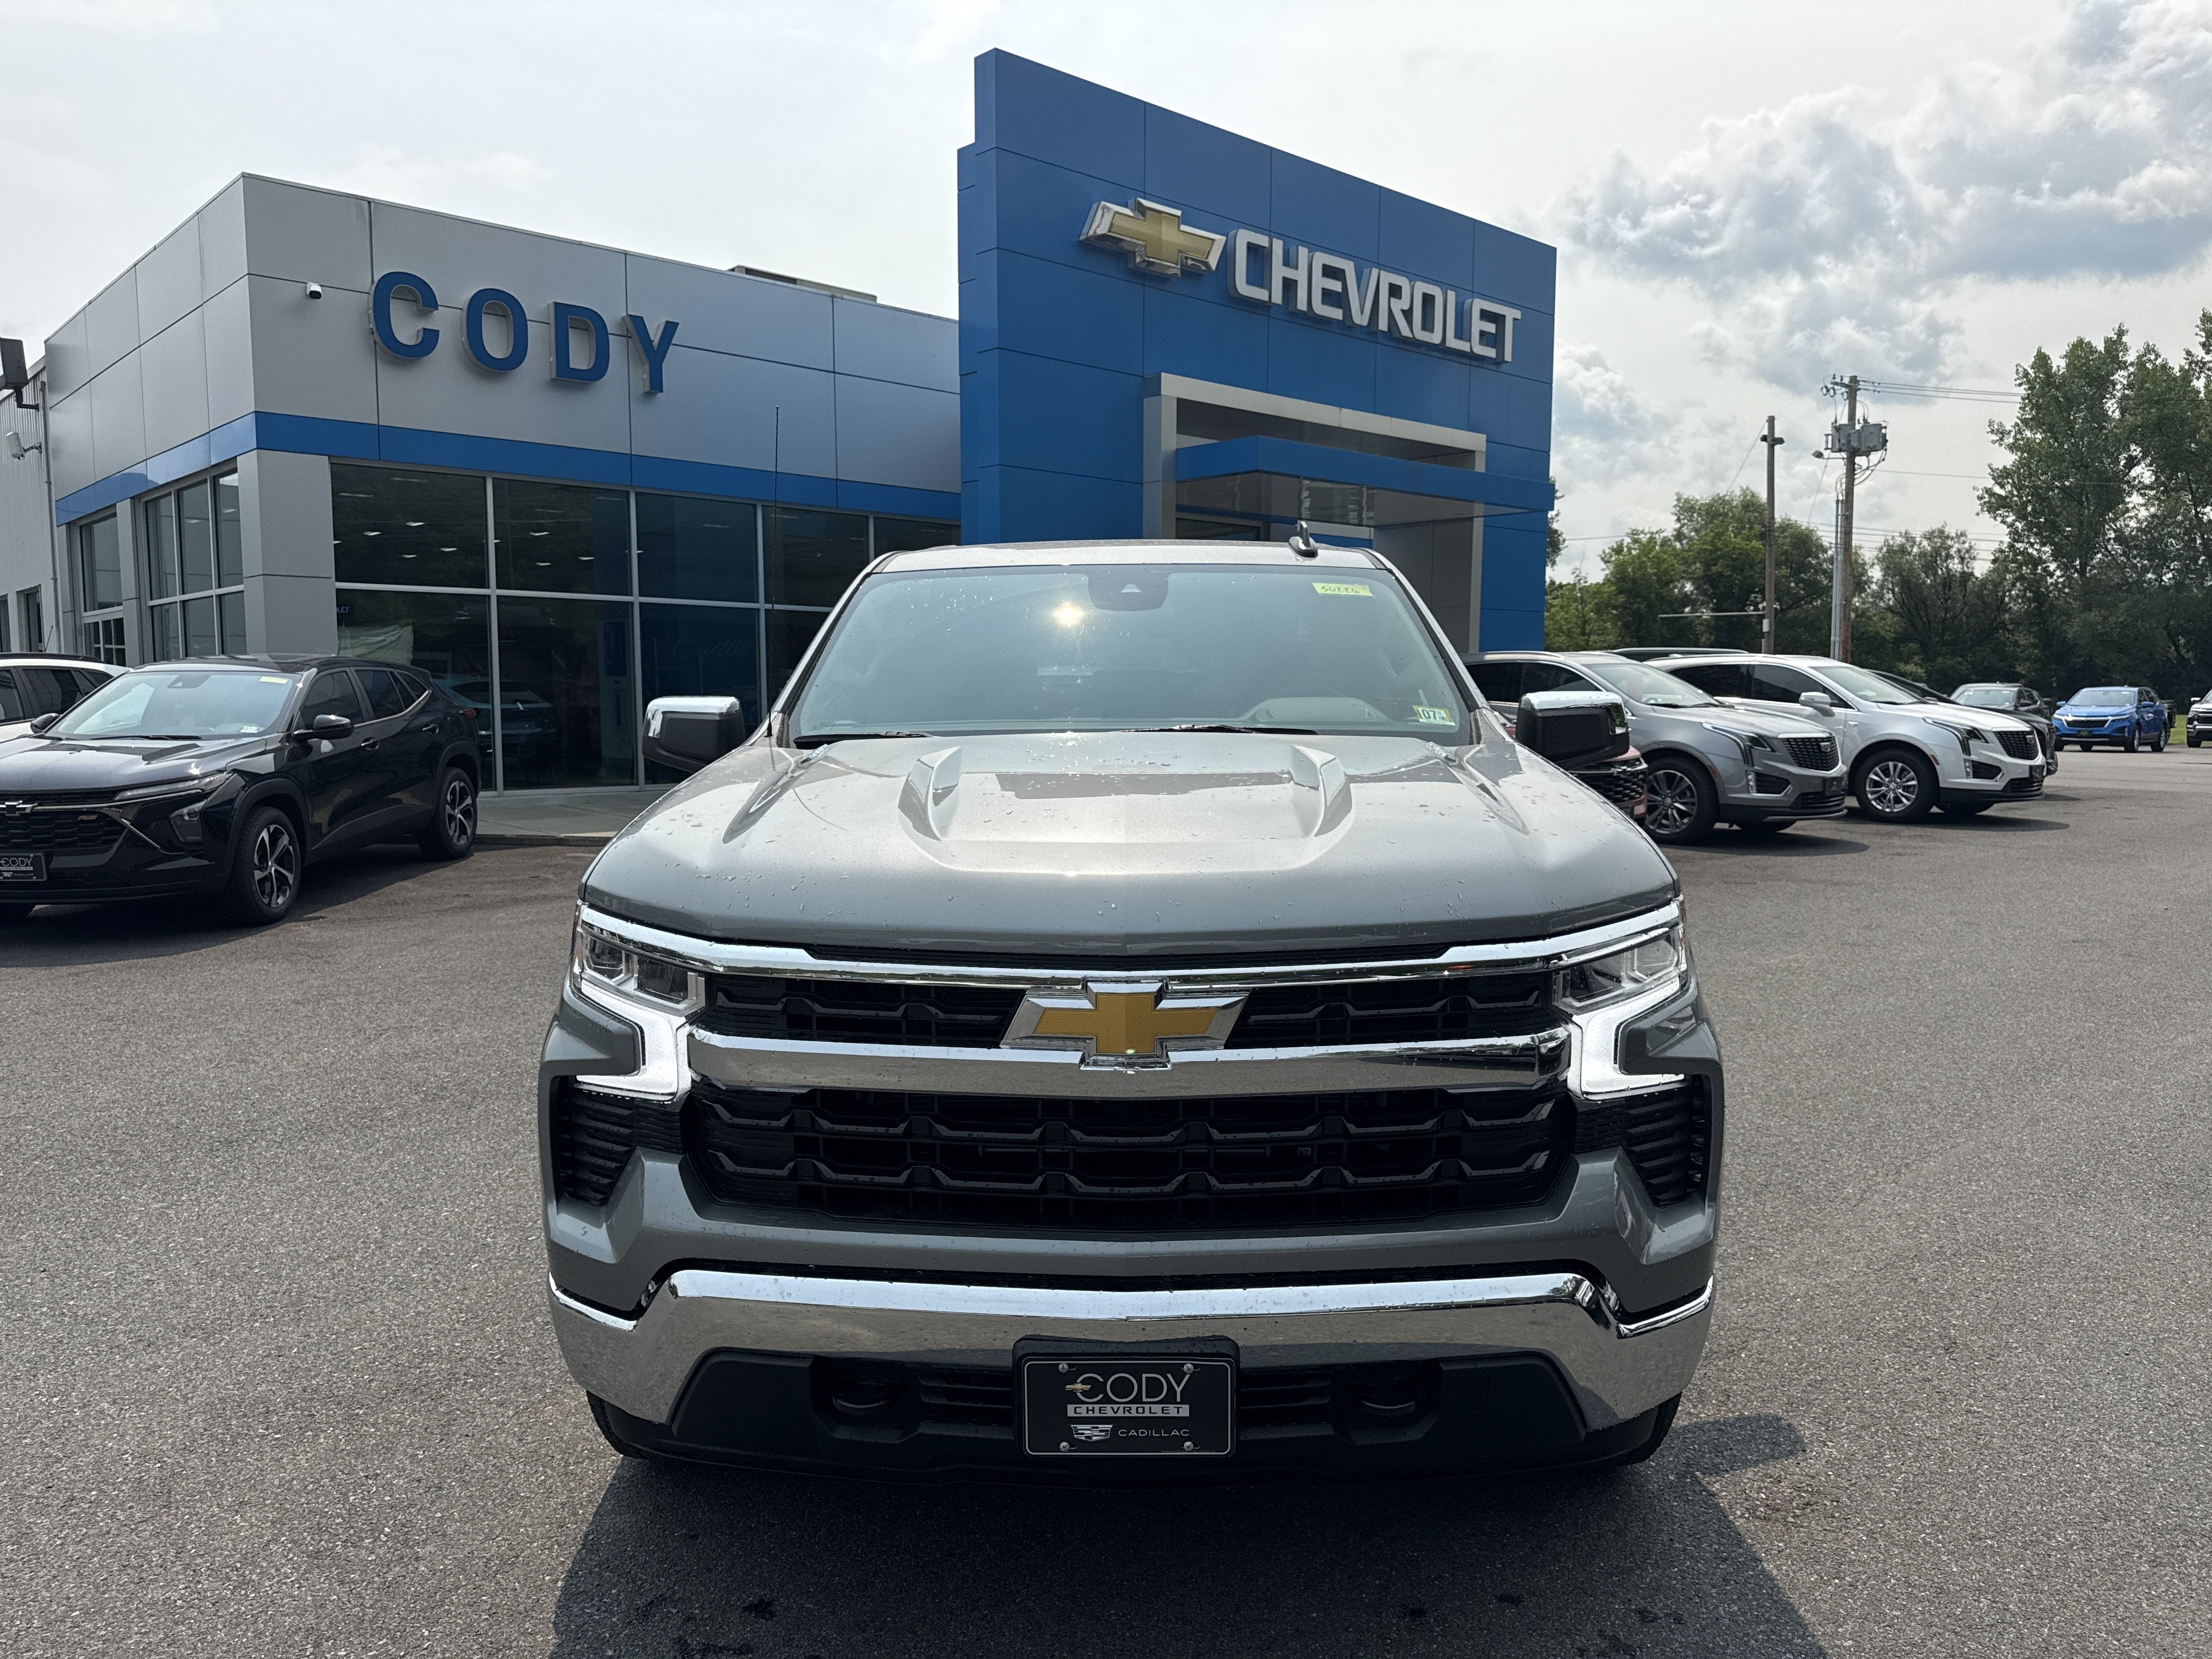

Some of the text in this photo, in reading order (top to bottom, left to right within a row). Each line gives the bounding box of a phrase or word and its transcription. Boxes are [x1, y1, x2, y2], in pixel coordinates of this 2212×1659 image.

[1227, 229, 1521, 363] CHEVROLET
[368, 271, 679, 394] CODY
[1421, 709, 1437, 720] 07
[1, 857, 32, 866] CODY
[1075, 1373, 1191, 1402] CODY
[1074, 1406, 1183, 1414] CHEVROLET
